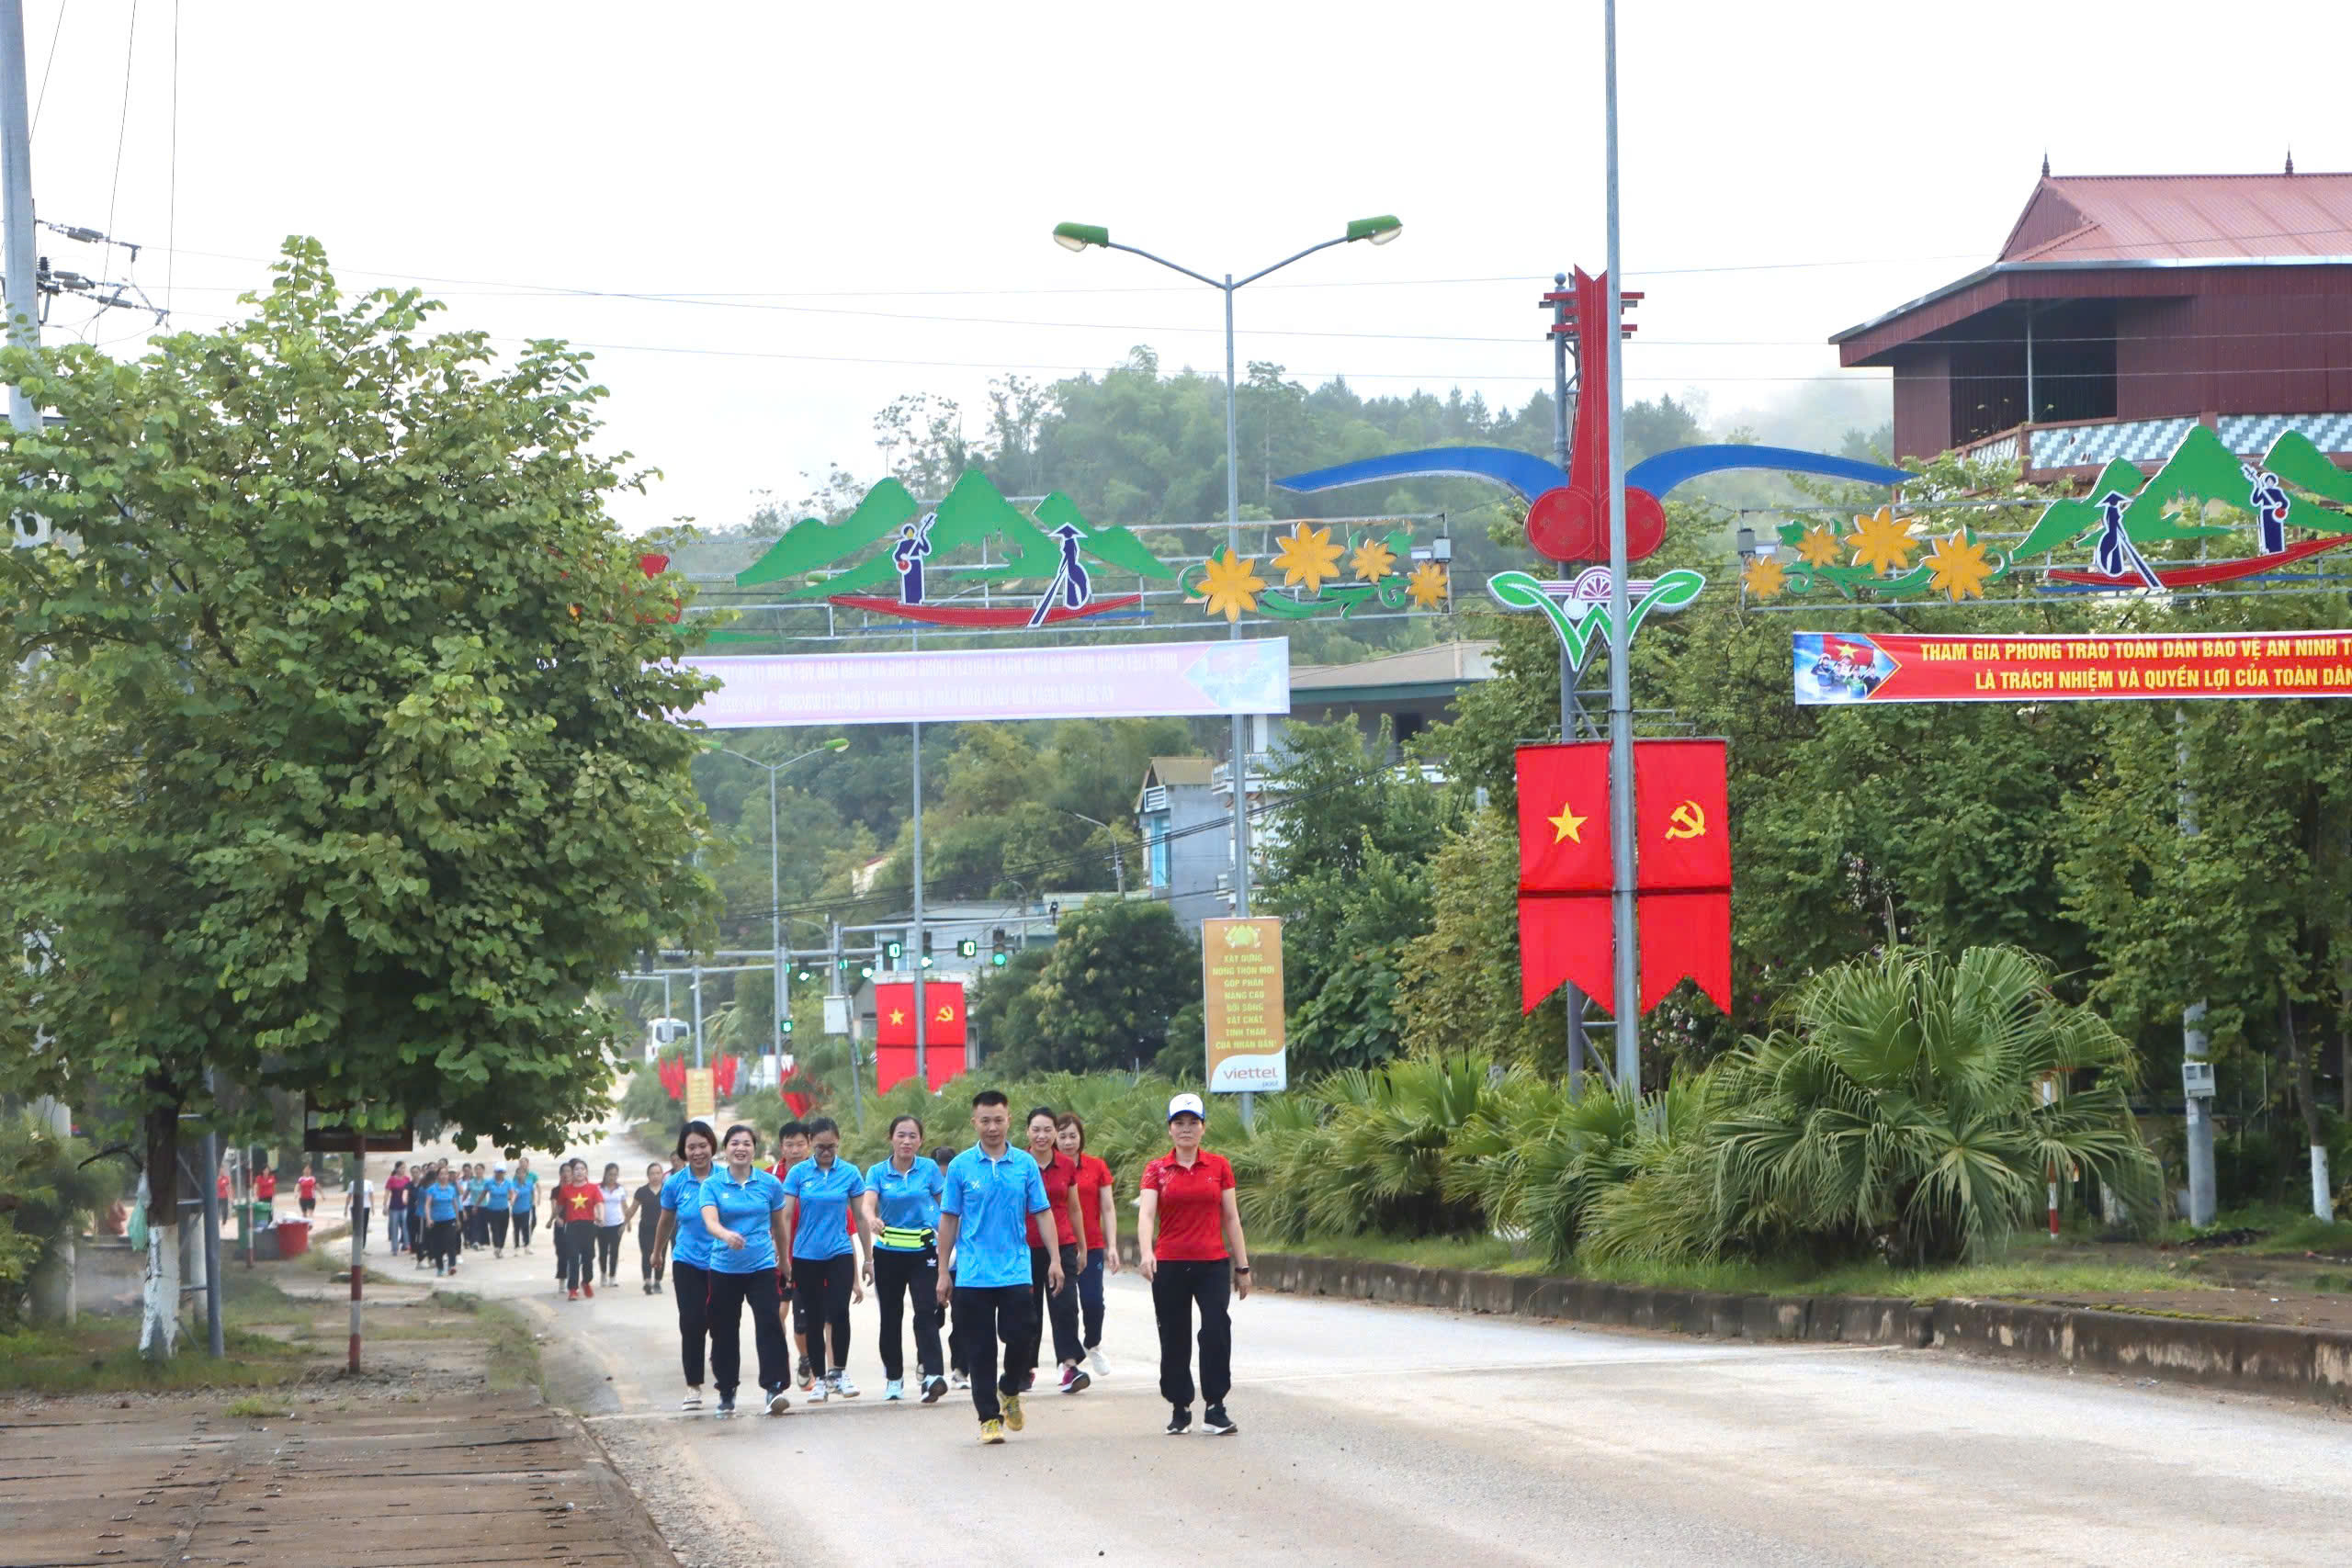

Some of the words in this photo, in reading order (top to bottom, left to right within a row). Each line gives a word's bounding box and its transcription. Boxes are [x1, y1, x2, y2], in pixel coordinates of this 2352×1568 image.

[1921, 644, 1967, 660] THAM
[1973, 644, 2000, 660] GIA
[2005, 643, 2062, 659] PHONG
[2163, 638, 2198, 658] DÂN
[2241, 637, 2261, 660] VỆ
[2267, 639, 2290, 657] AN
[2296, 638, 2337, 656] NINH
[2343, 638, 2352, 656] T
[1975, 668, 1996, 689] LÀ
[2000, 668, 2053, 689] TRÁCH
[2059, 667, 2113, 692] NHIỆM
[2118, 667, 2140, 688] VÀ
[2204, 668, 2230, 691] LỢI
[2235, 664, 2269, 687] CỦA
[2274, 664, 2318, 686] TOÀN
[1223, 1066, 1278, 1080] viettel
